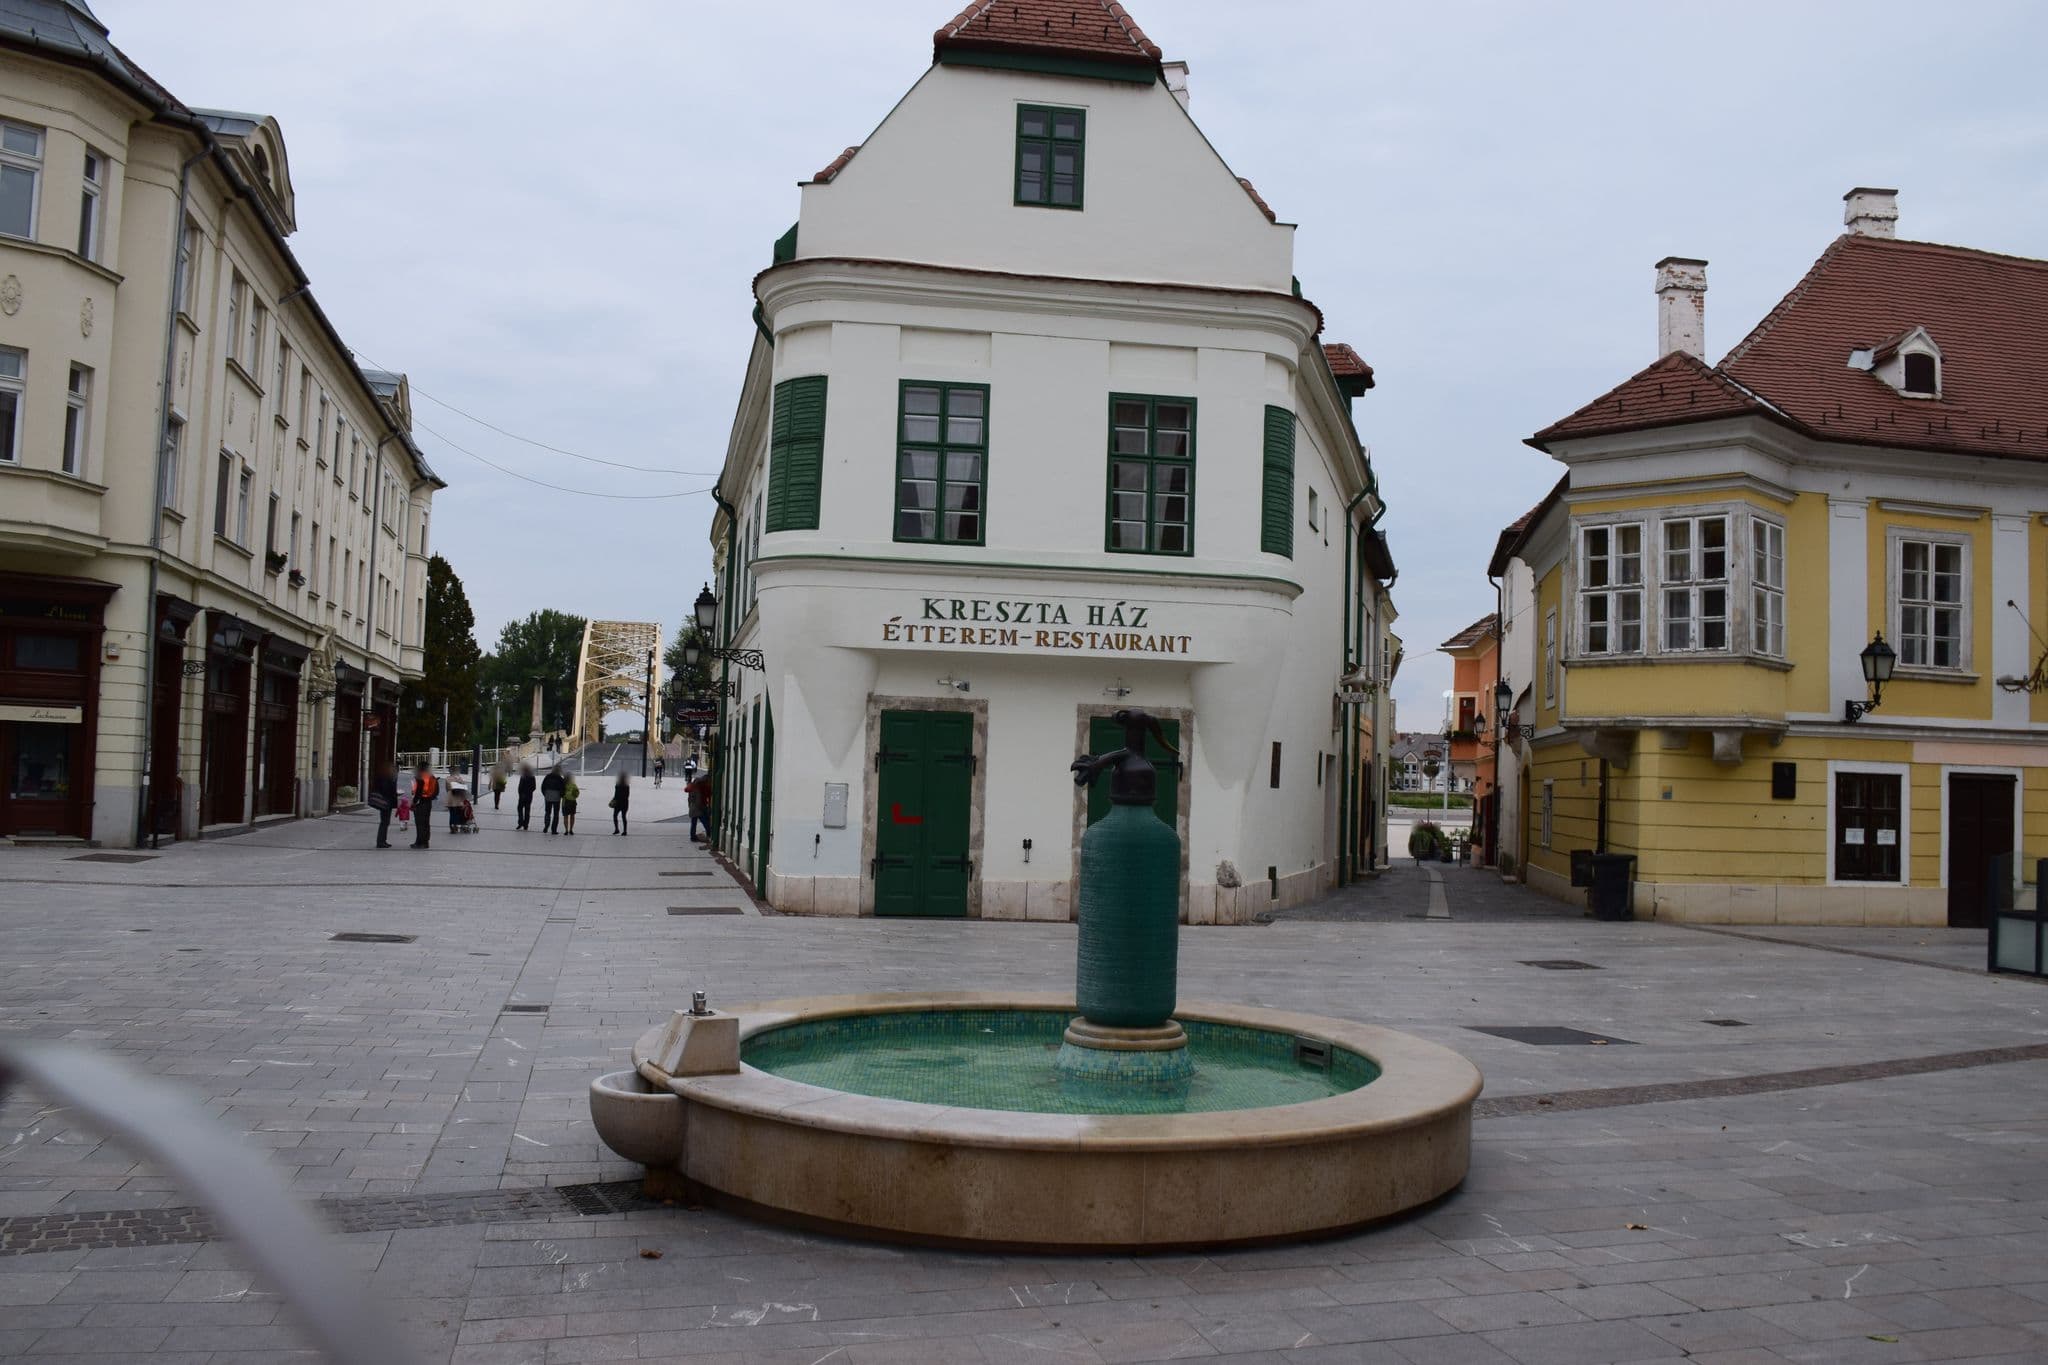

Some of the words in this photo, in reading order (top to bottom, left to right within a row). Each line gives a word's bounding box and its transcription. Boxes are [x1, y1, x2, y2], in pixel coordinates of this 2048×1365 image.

[921, 598, 1070, 625] KRESZTA
[1086, 601, 1149, 628] HÁZ
[882, 616, 1192, 653] ÉTTEREM-RESTAURANT
